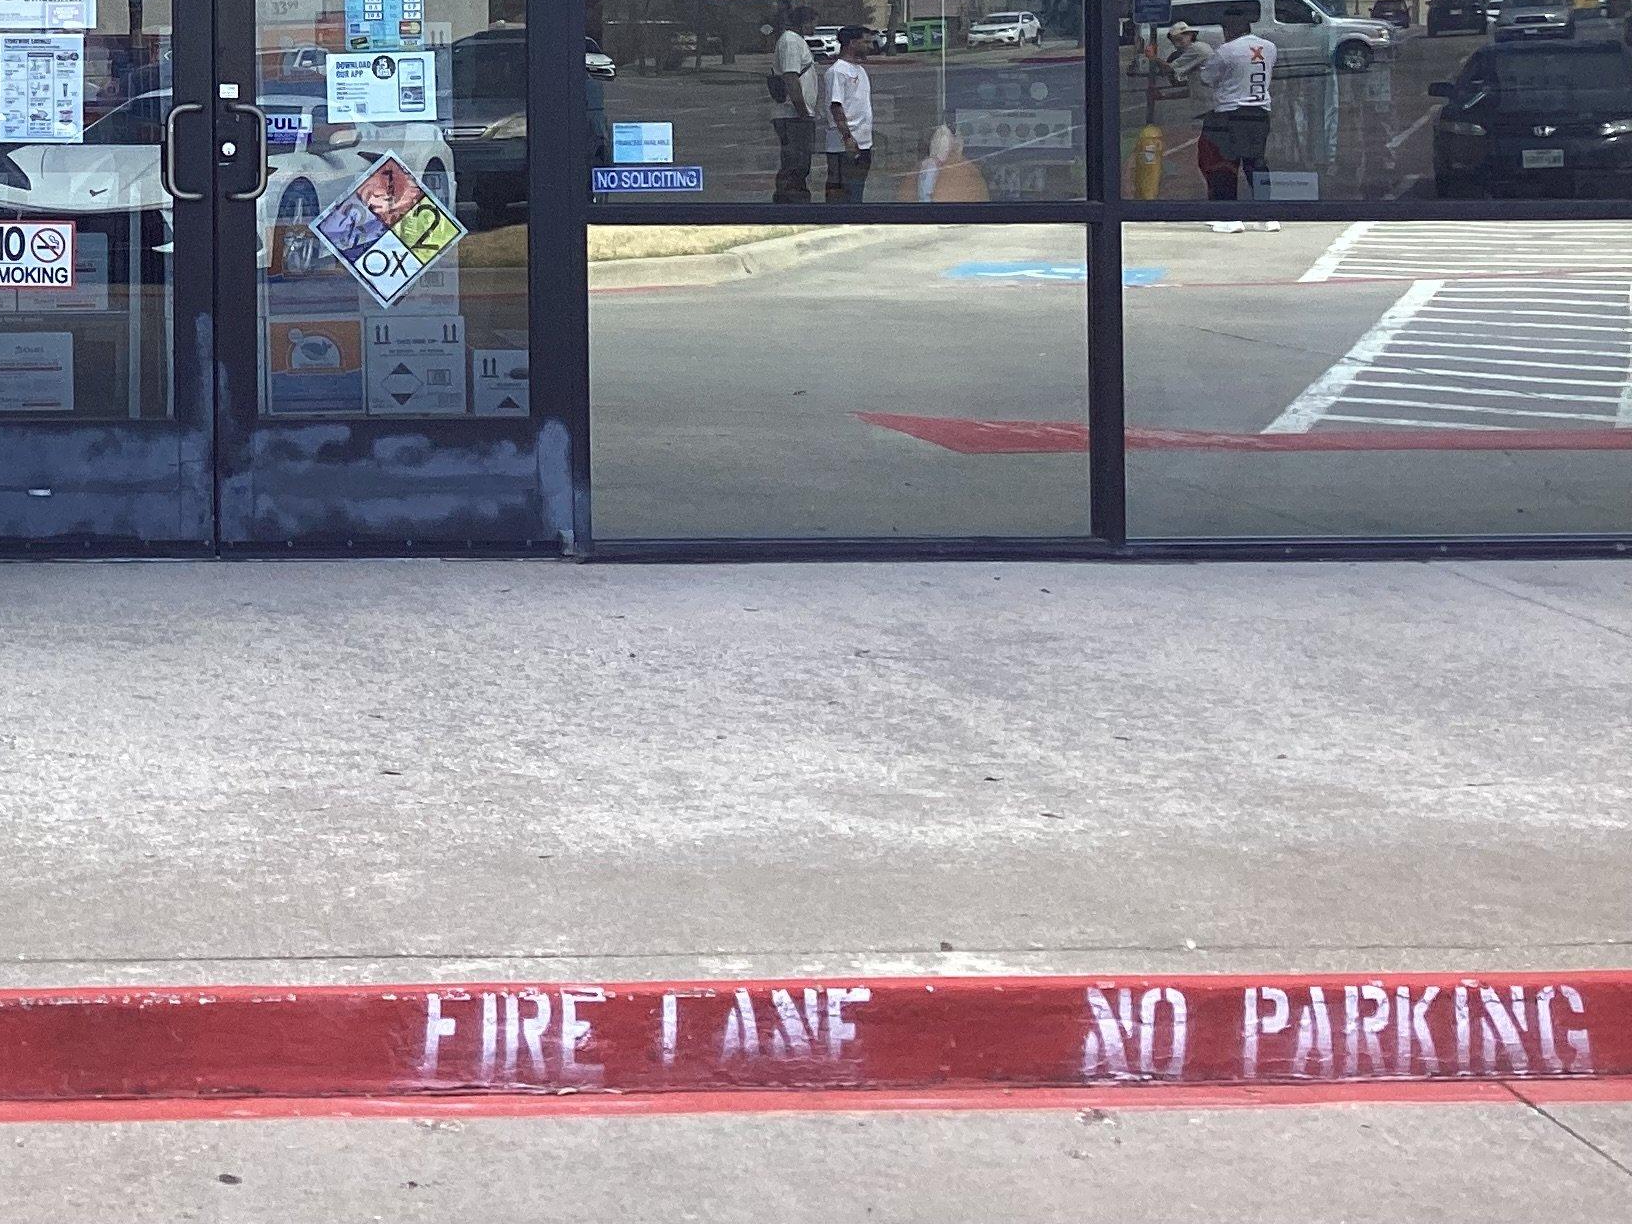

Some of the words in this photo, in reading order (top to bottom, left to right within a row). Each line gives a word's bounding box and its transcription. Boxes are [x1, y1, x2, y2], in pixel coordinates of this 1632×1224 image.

[336, 60, 371, 70] DOWNLOAD
[351, 70, 364, 78] APP
[597, 172, 618, 188] NO
[621, 171, 697, 187] SOLICITING
[410, 203, 441, 251] 2
[362, 249, 409, 277] OX
[418, 987, 607, 1079] FIRE
[1082, 986, 1187, 1081] NO
[1243, 983, 1593, 1077] PARKING
